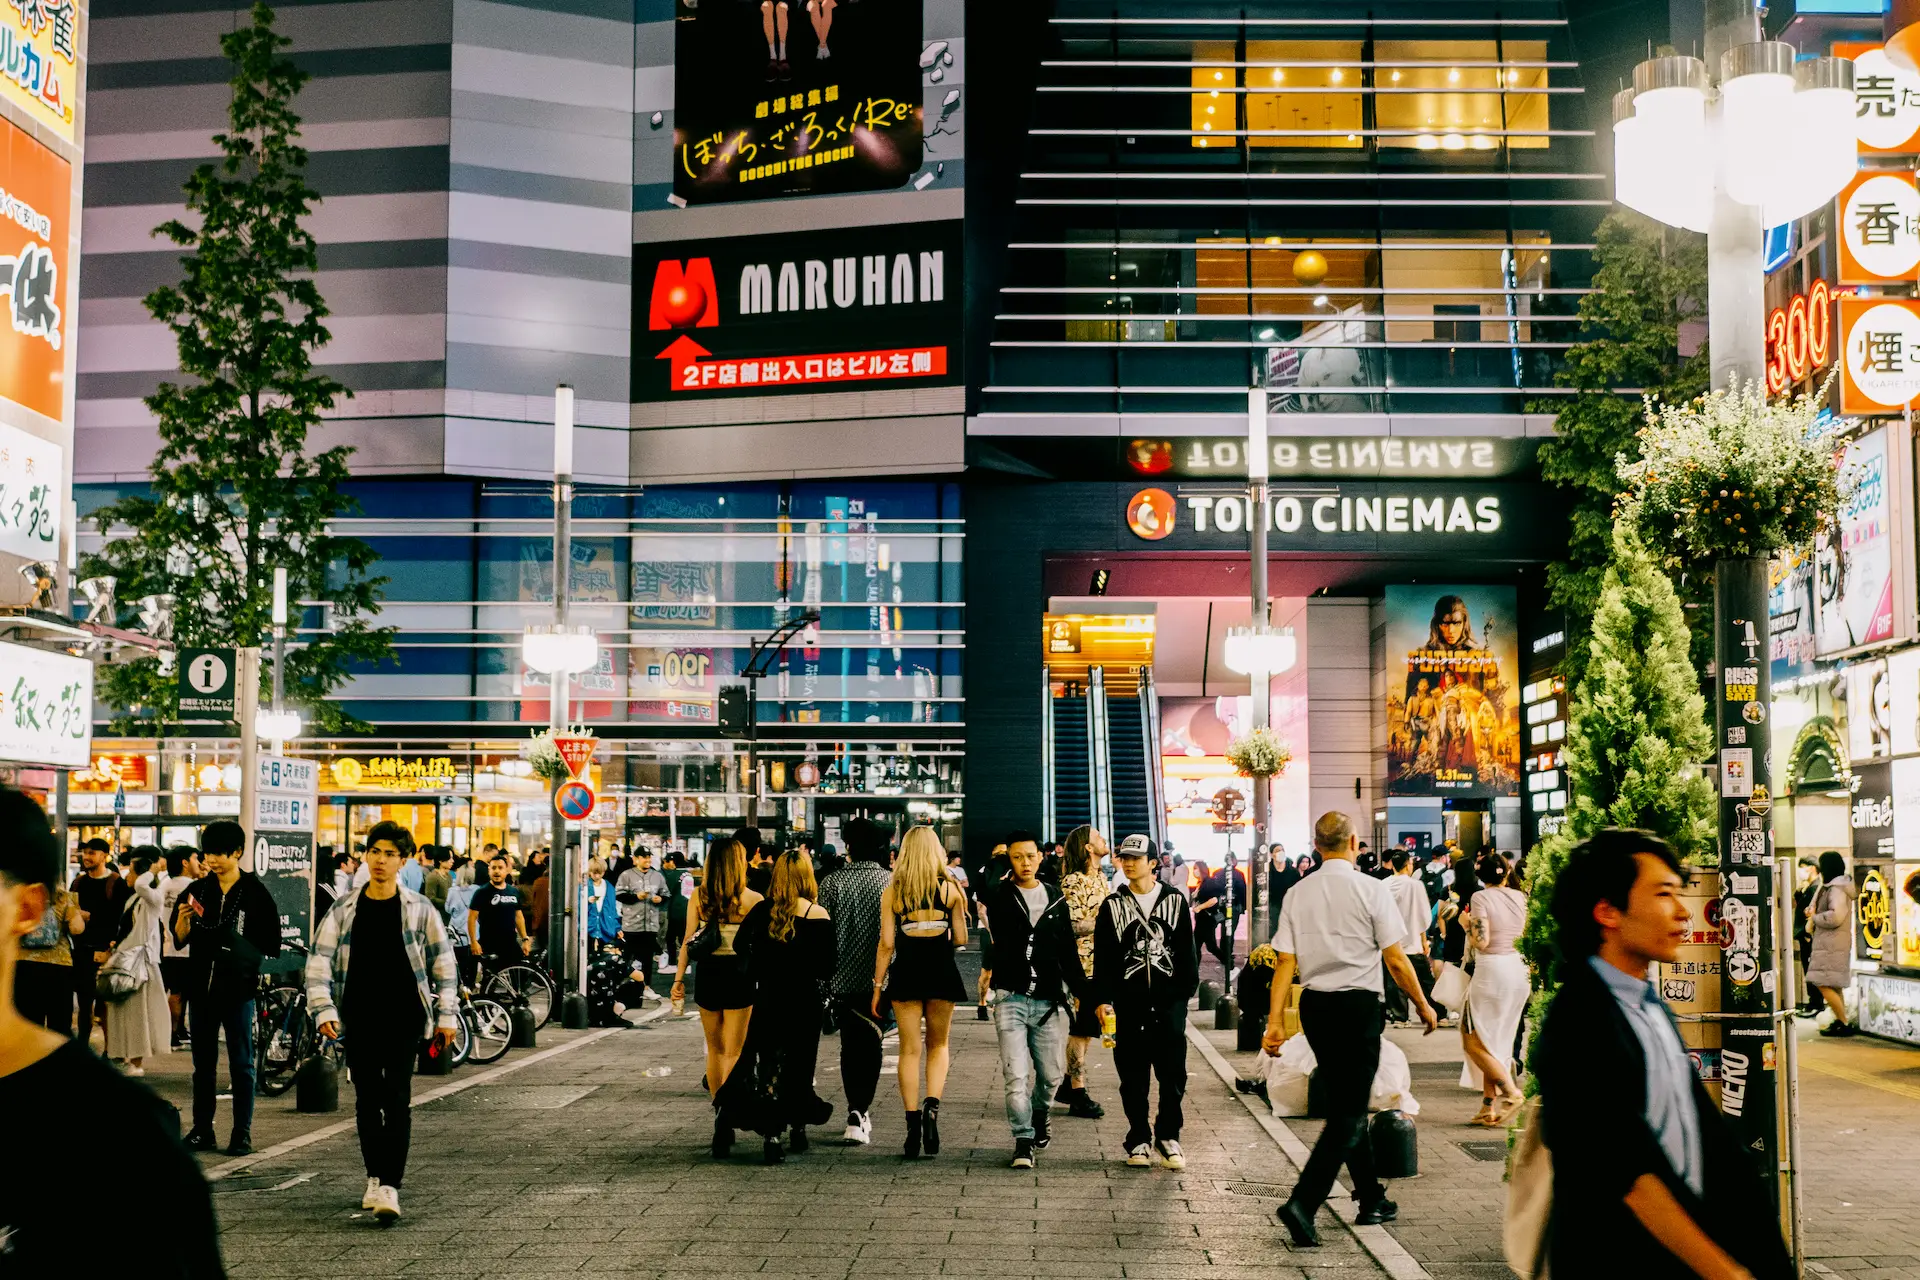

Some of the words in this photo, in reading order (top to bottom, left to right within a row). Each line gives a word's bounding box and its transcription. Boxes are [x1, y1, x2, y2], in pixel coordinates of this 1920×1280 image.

[1857, 75, 1896, 118] 売
[789, 155, 812, 171] THE
[1855, 202, 1900, 246] 香
[740, 250, 943, 315] MARUHAN
[683, 352, 932, 387] 2F店舗出入口はビル左側
[1859, 331, 1903, 374] 煙
[1311, 496, 1502, 533] CINEMAS
[563, 742, 590, 752] 止まれ
[567, 753, 587, 761] STOP
[283, 763, 292, 777] JR
[1671, 962, 1720, 975] 車道は左
[1721, 1049, 1749, 1117] NERO
